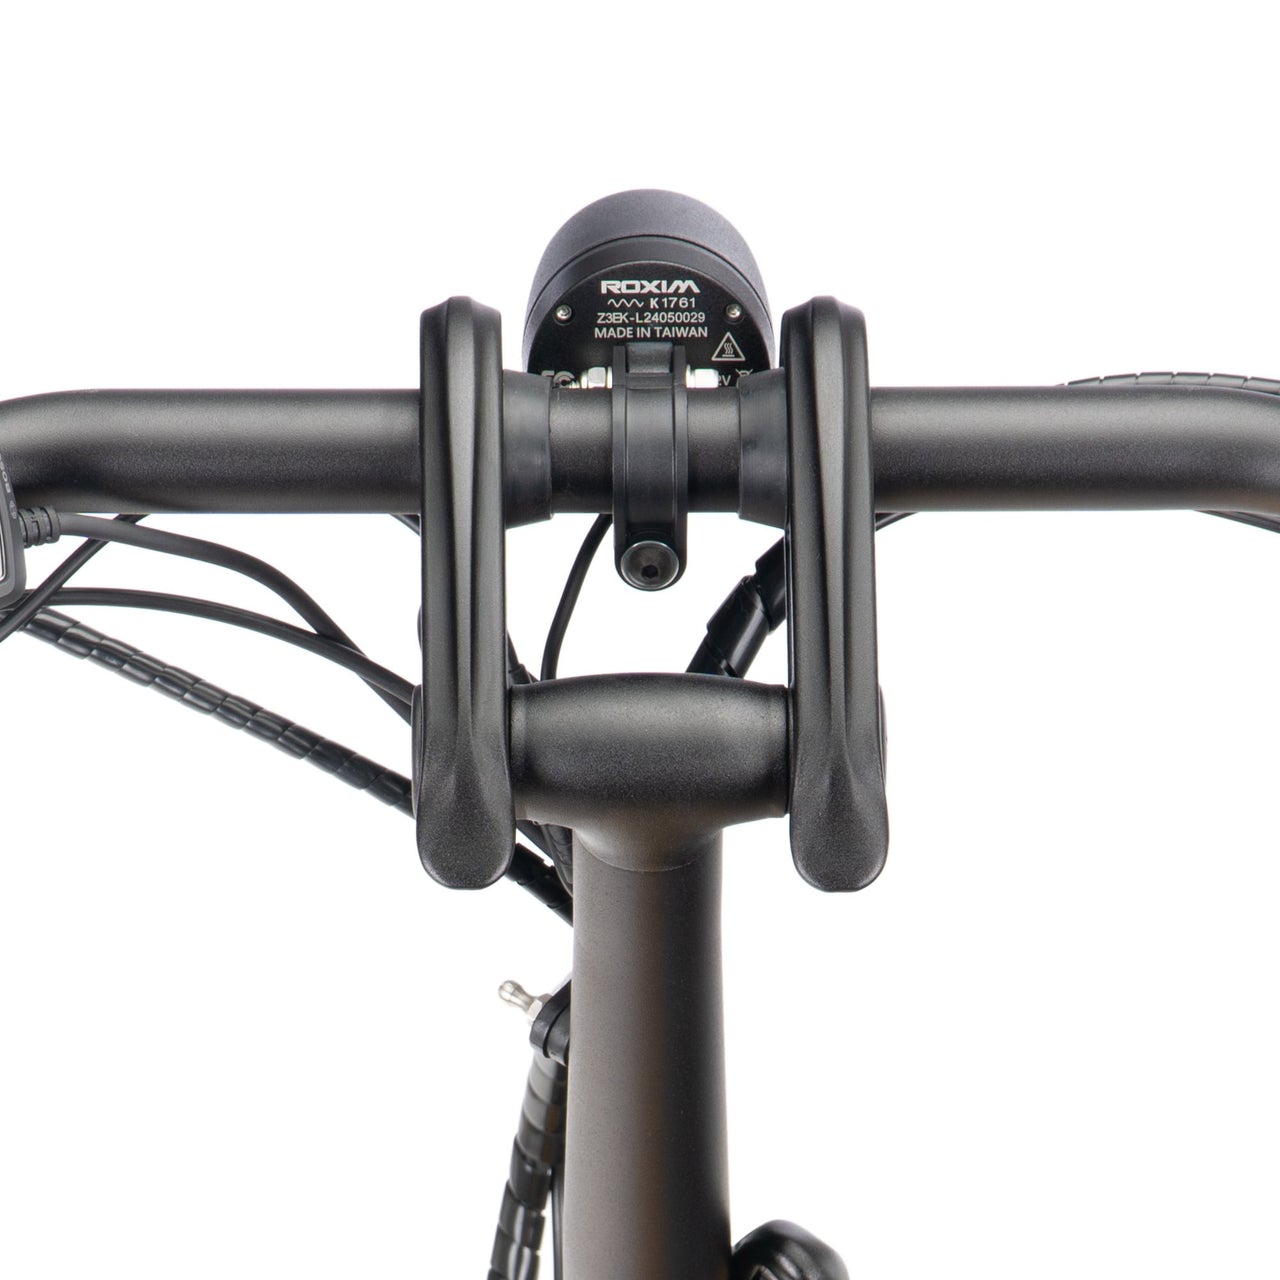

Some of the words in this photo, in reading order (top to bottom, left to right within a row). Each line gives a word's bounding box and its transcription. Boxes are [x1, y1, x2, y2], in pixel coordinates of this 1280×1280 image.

[600, 280, 701, 294] ROXIM
[597, 311, 706, 324] Z3EK-L24050029
[594, 326, 634, 339] MADE
[637, 326, 651, 339] IN
[654, 325, 708, 338] TAIWAN
